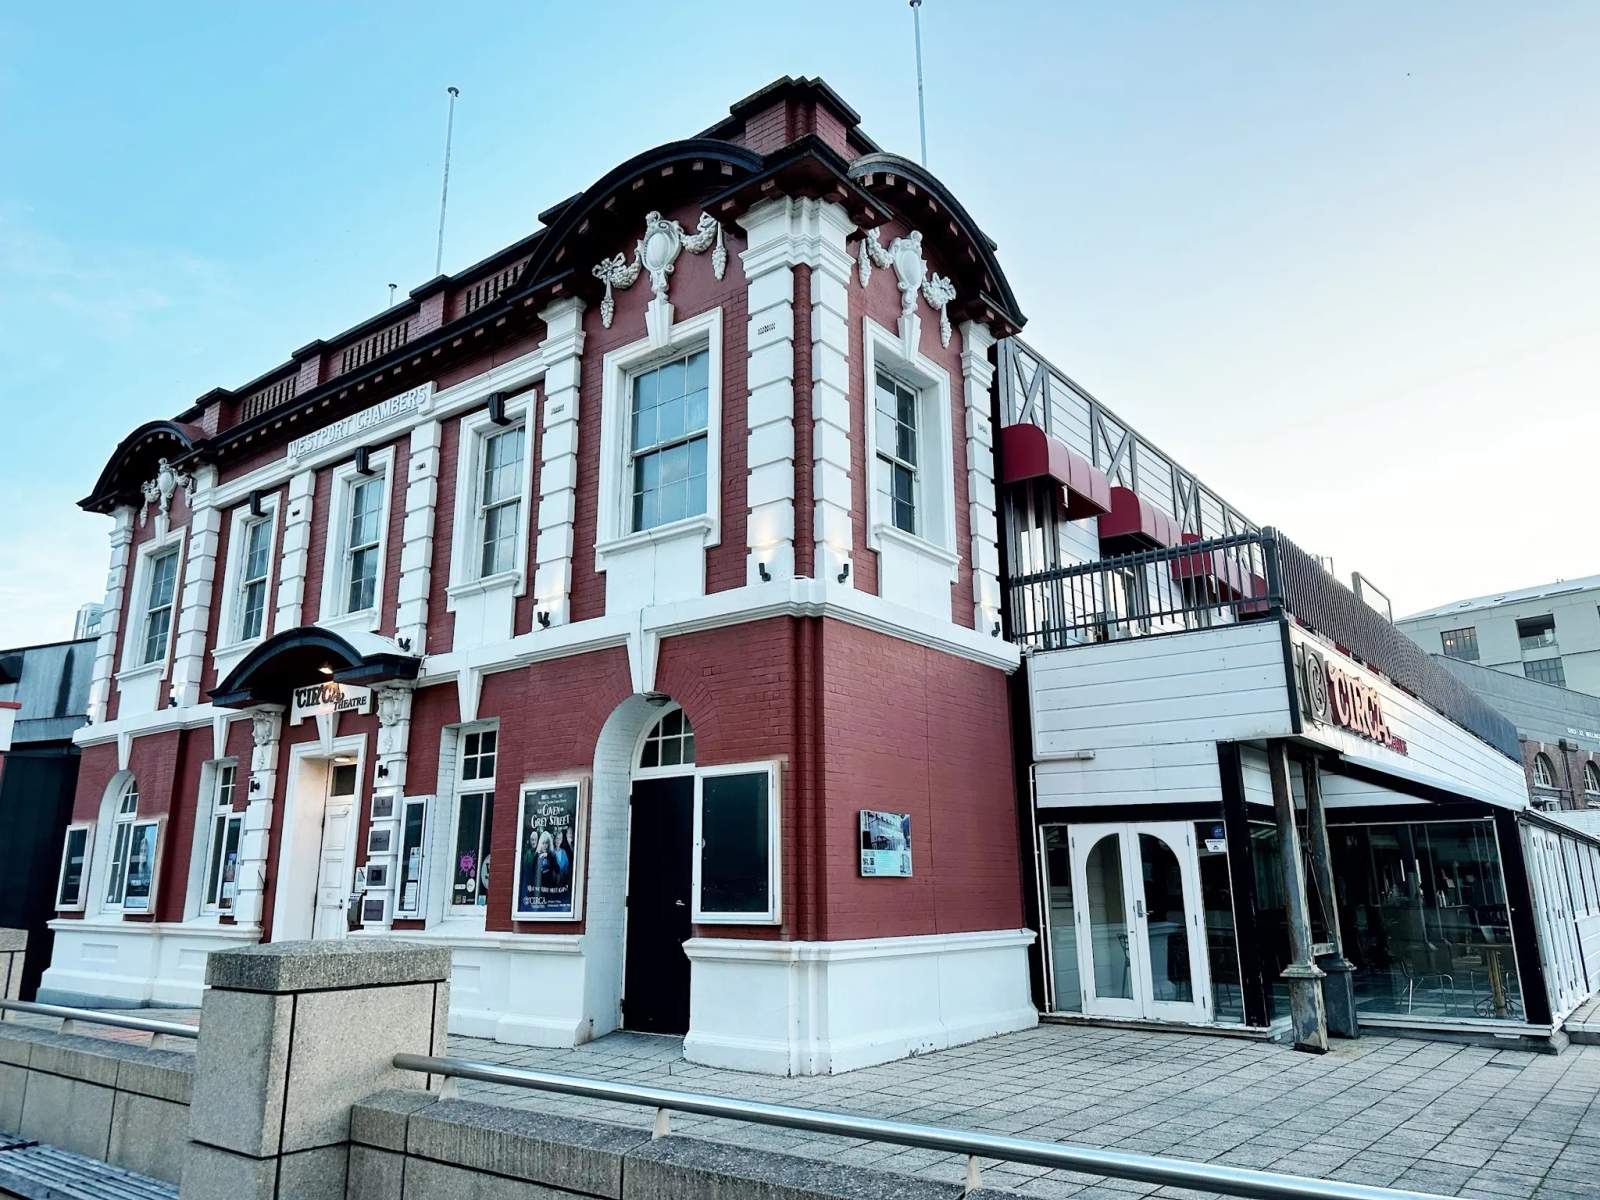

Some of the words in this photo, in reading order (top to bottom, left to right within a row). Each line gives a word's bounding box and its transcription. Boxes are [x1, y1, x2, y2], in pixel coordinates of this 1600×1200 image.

[289, 419, 353, 458] WESTPORT
[357, 386, 427, 429] CHAMBERS
[334, 696, 367, 711] THEATRE
[1328, 661, 1392, 745] CIRCA
[531, 814, 547, 829] GREY
[549, 814, 570, 826] STREET
